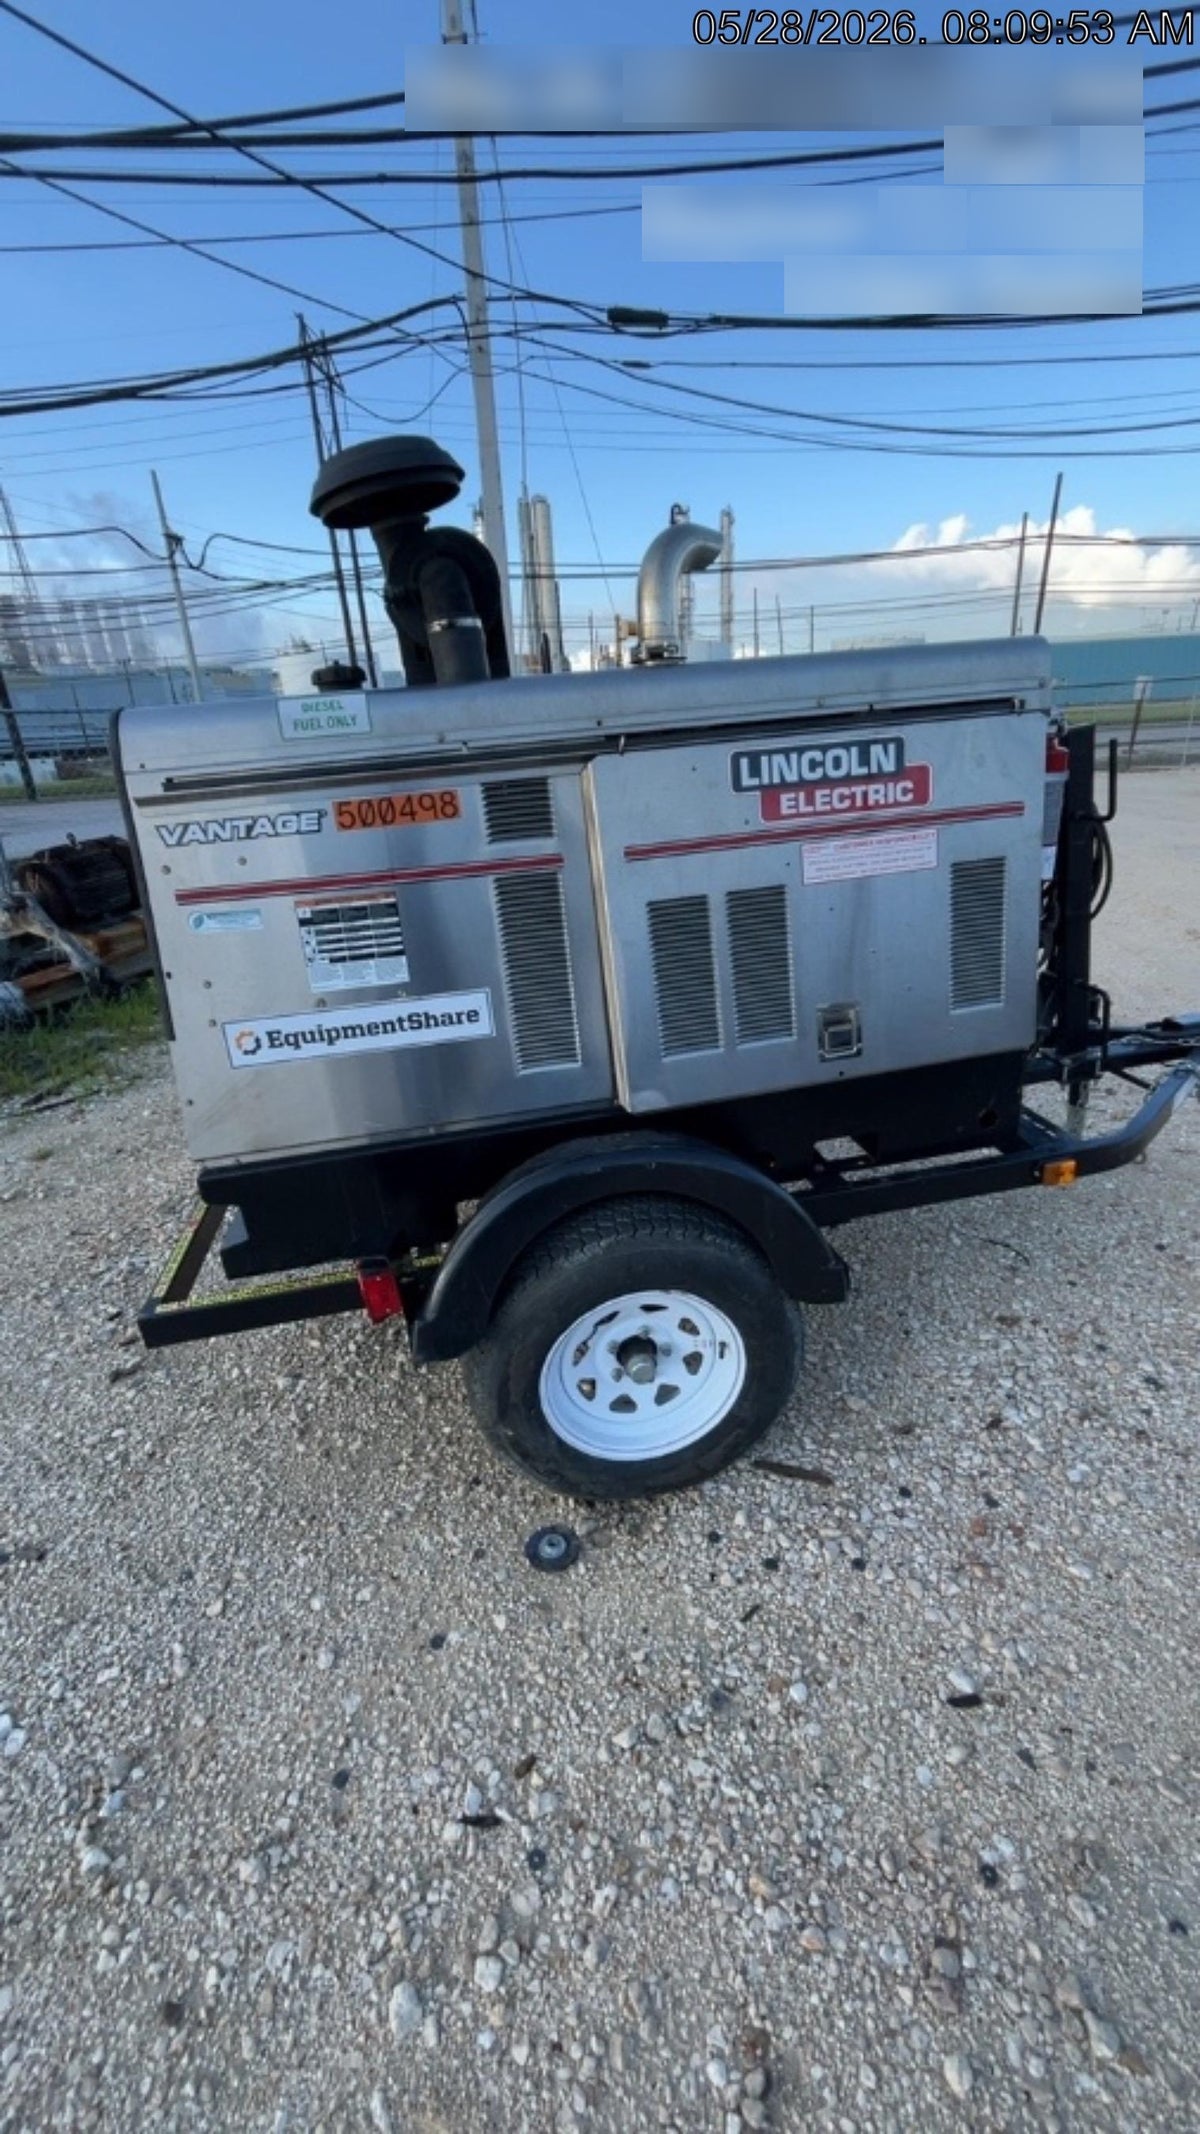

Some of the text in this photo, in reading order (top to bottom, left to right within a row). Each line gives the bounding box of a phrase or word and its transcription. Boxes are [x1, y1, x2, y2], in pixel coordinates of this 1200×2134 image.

[293, 714, 357, 732] FUEL ONLY
[301, 699, 344, 713] DIESEL
[739, 743, 897, 788] LINCOLN
[336, 791, 459, 829] 500498
[779, 780, 914, 815] ELECTRIC
[265, 1008, 480, 1050] EquipmentShare
